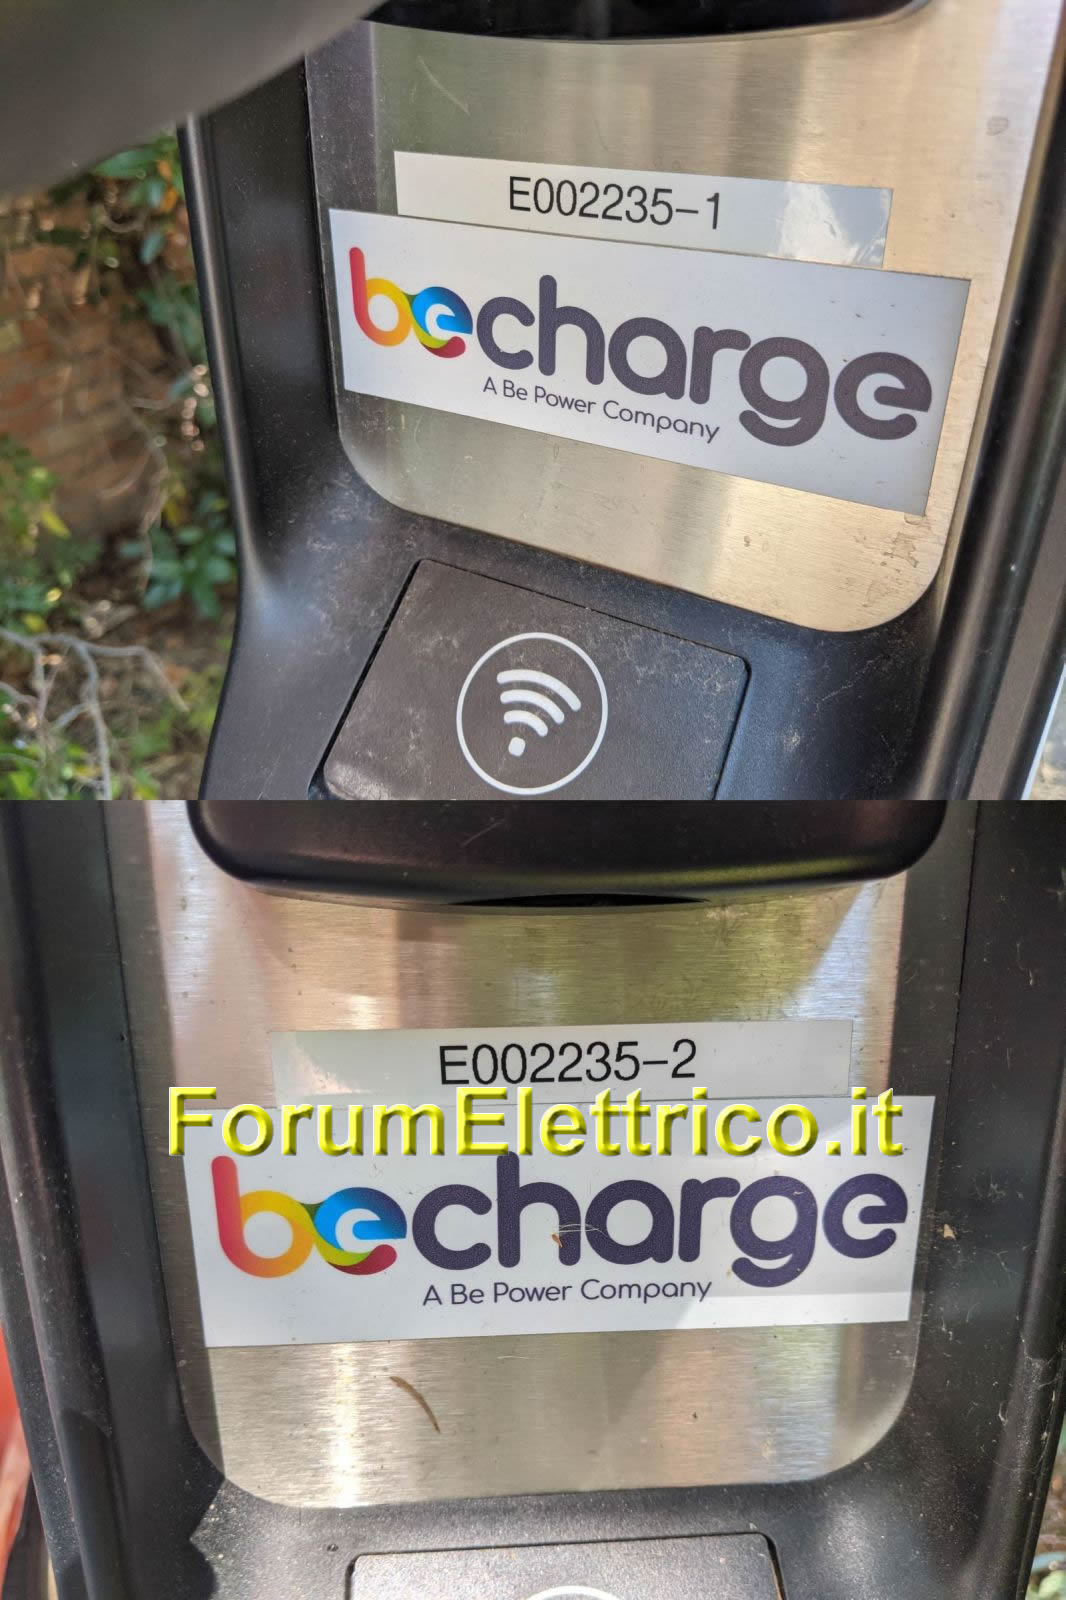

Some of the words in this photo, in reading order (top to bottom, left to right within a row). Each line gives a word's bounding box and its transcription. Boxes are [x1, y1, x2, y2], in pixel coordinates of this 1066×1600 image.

[508, 176, 721, 230] E002235-1
[349, 246, 933, 446] becharge
[482, 376, 498, 394] A
[503, 379, 529, 399] Be
[534, 385, 597, 415] Power
[602, 400, 720, 443] Company
[439, 1038, 697, 1086] E002235-2
[211, 1151, 908, 1288] becharge
[422, 1285, 443, 1306] A
[451, 1284, 486, 1305] Be
[494, 1280, 574, 1304] Power
[580, 1277, 712, 1305] Company
